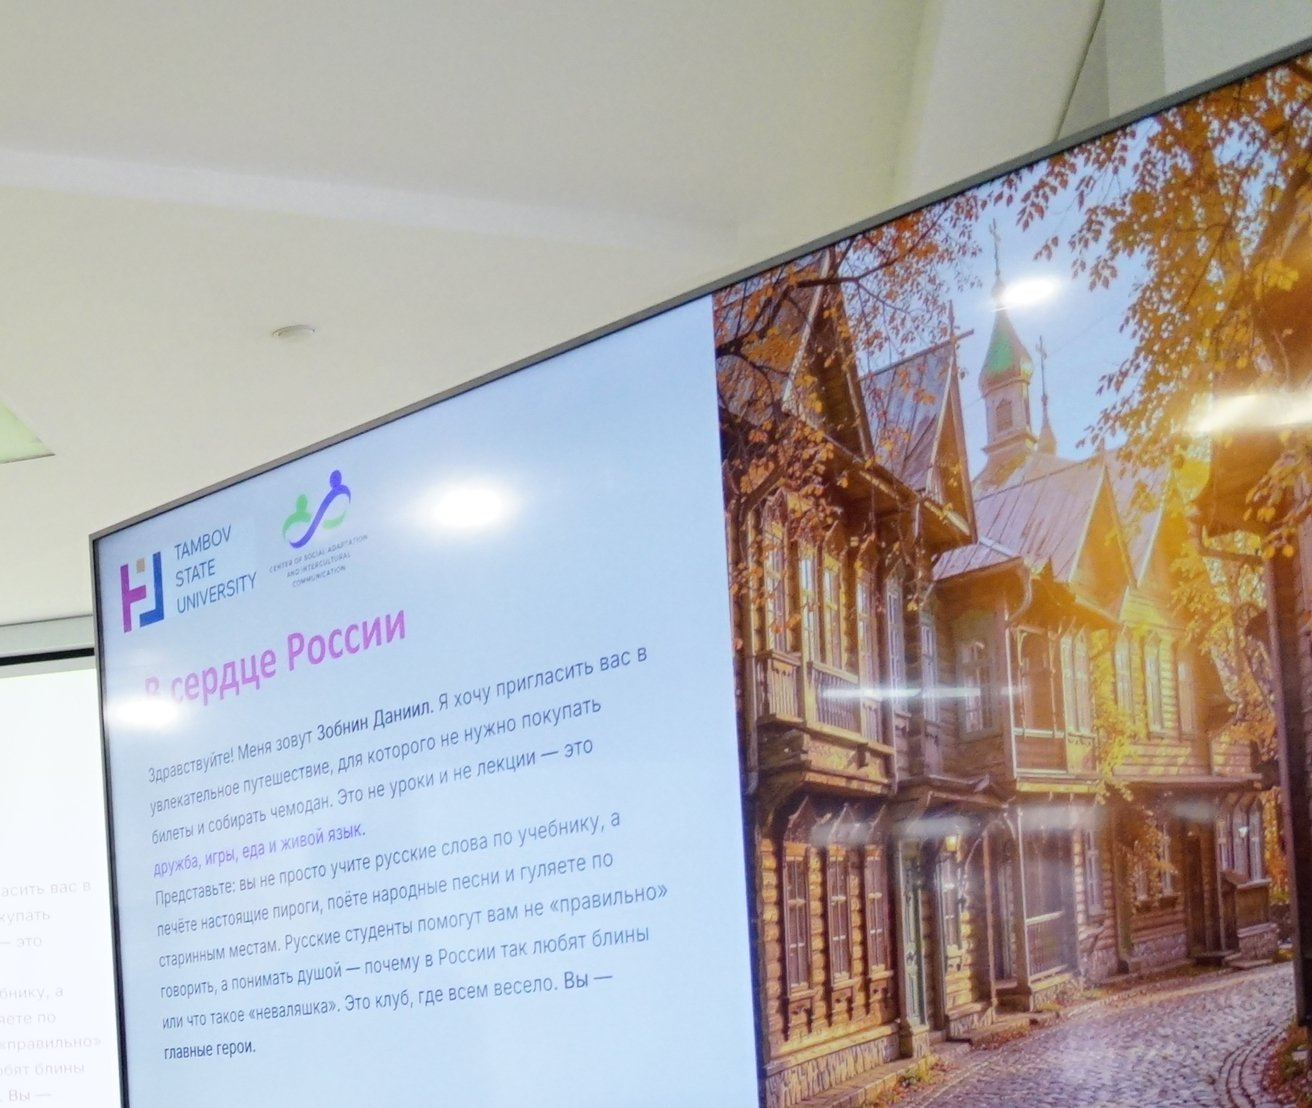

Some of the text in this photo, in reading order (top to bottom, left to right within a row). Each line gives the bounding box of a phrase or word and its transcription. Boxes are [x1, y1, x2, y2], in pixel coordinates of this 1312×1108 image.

[174, 525, 232, 560] TAMBOV
[174, 556, 216, 588] STATE
[175, 569, 258, 614] UNIVERSITY
[171, 649, 277, 706] сердце
[287, 609, 405, 671] России
[147, 645, 648, 785] Здравствуйте! Меня зовут Зобнин Даниил. Я хочу пригласить вас в
[149, 697, 602, 818] увлекательное путешествие, для которого не нужно покупать
[150, 823, 194, 845] билеты
[196, 821, 205, 835] и
[207, 809, 267, 833] собирать
[269, 794, 333, 819] чемодан.
[336, 787, 364, 806] Это
[366, 782, 385, 800] не
[388, 772, 434, 800] уроки
[438, 768, 449, 785] и
[452, 763, 472, 781] не
[476, 749, 536, 777] лекции
[563, 737, 594, 759] это
[152, 822, 366, 878] дружба, игры, еда и живой язык.
[154, 810, 621, 908] Представьте: вы не просто учите русские слова по учебнику, а
[156, 851, 614, 937] печёте настоящие пироги, поёте народные песни и гуляете по
[157, 883, 668, 969] старинным местам. Русские студенты помогут вам не «правильно»
[159, 980, 218, 999] говорить,
[220, 978, 228, 992] а
[230, 970, 294, 990] понимать
[296, 959, 342, 987] душой
[363, 954, 420, 975] почему
[423, 952, 434, 968] в
[437, 944, 496, 966] России
[499, 941, 528, 958] так
[531, 932, 587, 955] любят
[590, 925, 650, 948] блины
[161, 1015, 184, 1030] или
[185, 1012, 207, 1027] что
[208, 1008, 245, 1025] такое
[247, 999, 341, 1020] «неваляшка».
[343, 993, 371, 1012] Это
[374, 987, 414, 1011] клуб,
[417, 987, 444, 1007] где
[447, 983, 489, 1001] всем
[492, 976, 558, 997] весело.
[562, 969, 589, 990] Вы
[163, 1040, 256, 1060] главные герои.
